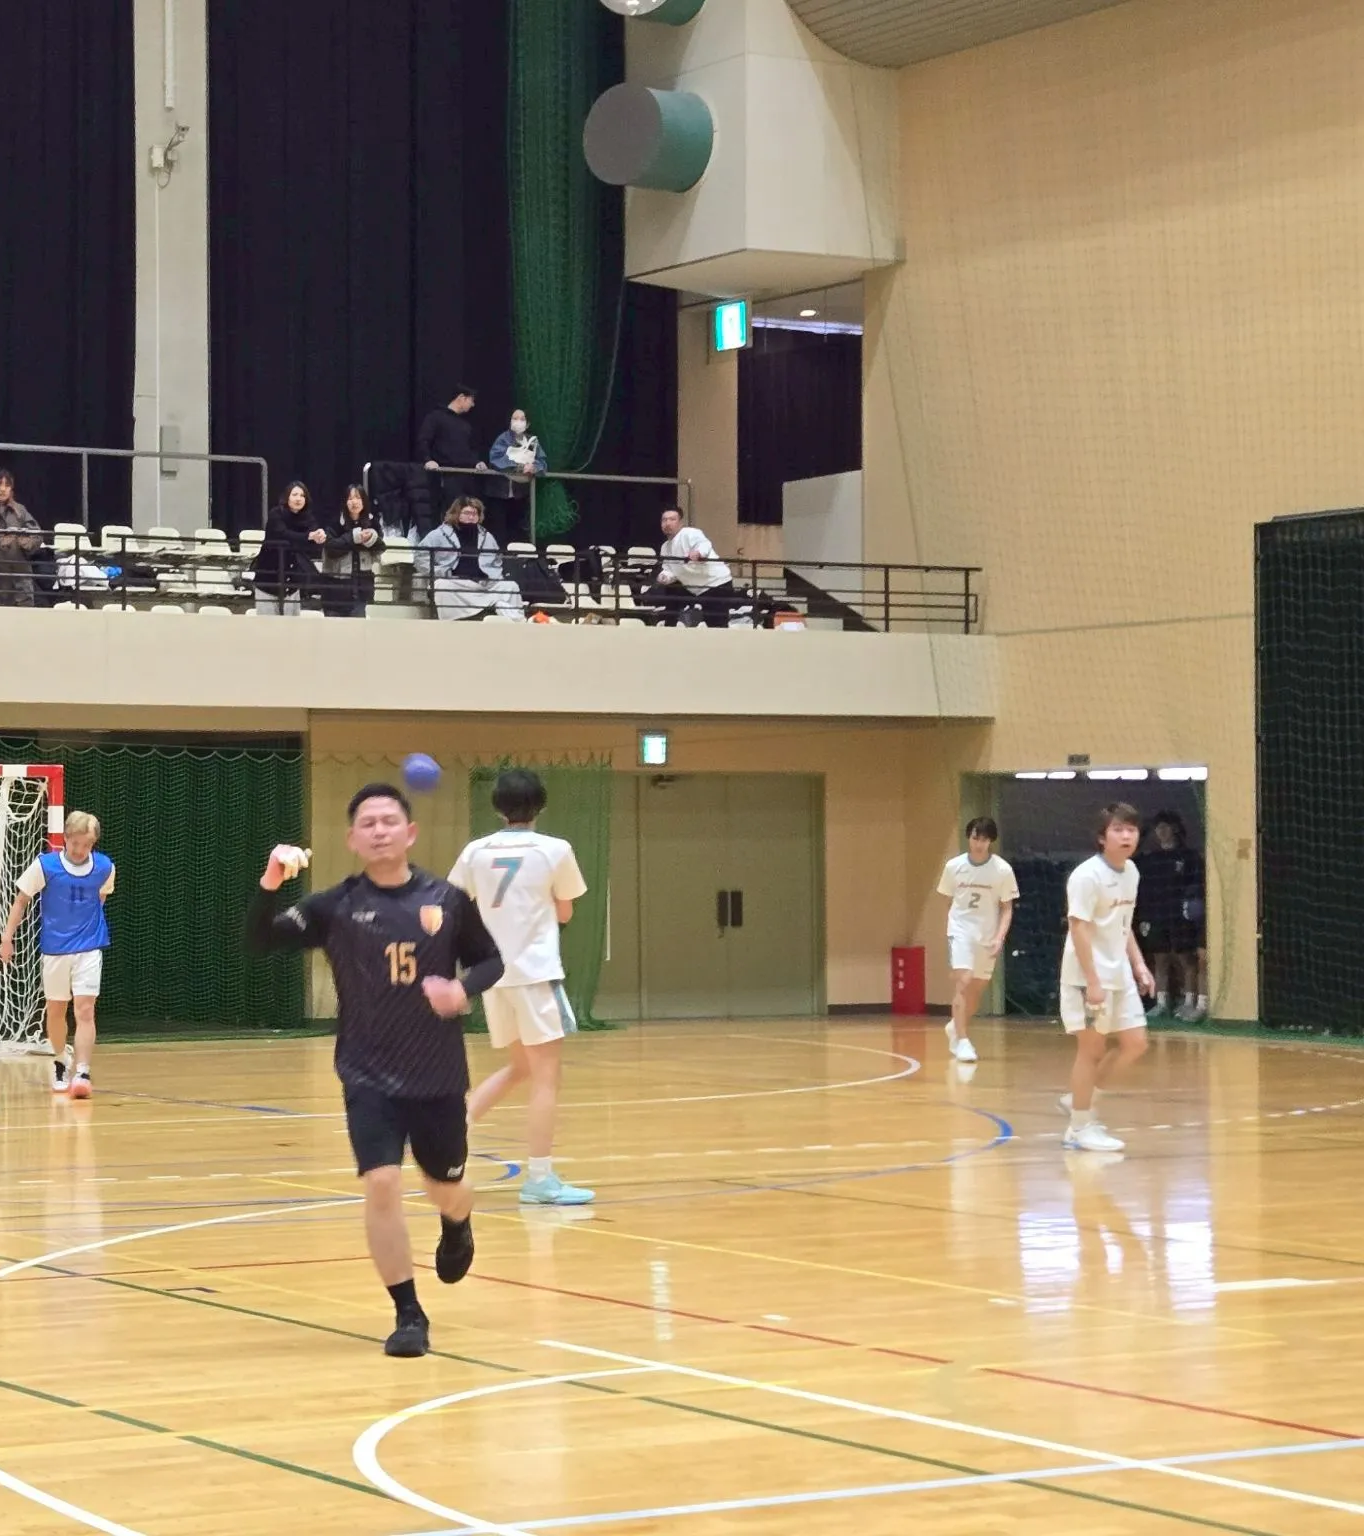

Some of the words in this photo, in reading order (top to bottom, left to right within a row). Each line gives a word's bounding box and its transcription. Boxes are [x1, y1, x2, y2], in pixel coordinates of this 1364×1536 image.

[491, 856, 523, 908] 7
[968, 892, 982, 909] 2
[385, 941, 418, 986] 15
